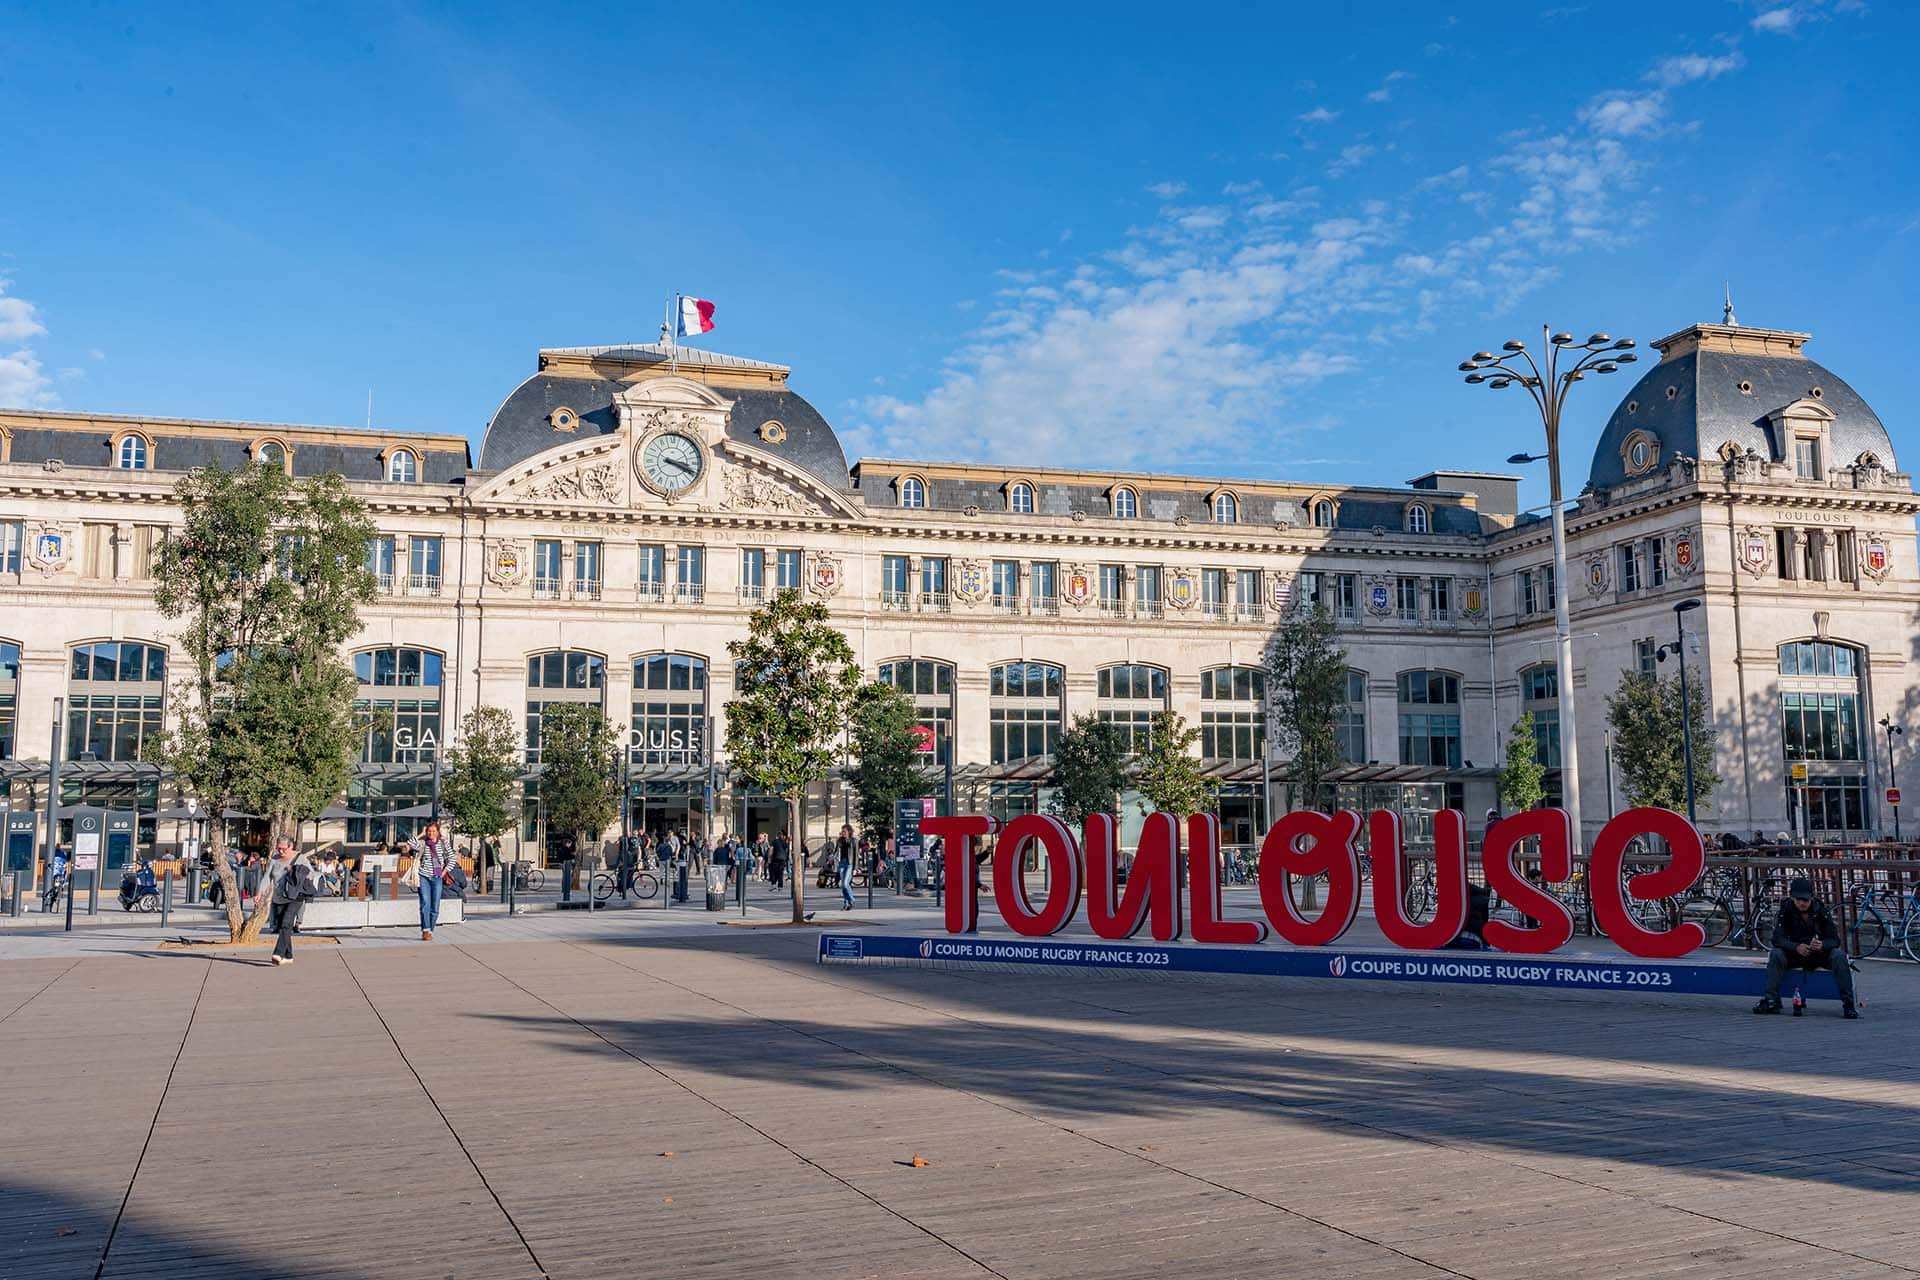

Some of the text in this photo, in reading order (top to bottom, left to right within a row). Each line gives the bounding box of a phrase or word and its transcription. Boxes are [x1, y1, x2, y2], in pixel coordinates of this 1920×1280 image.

[1776, 511, 1850, 522] TOULOUSE
[561, 524, 780, 543] CHEMINS DE FER DU MIDI
[935, 943, 1169, 965] COUPE DU MONDE RUGBY FRANCE 2023
[1351, 960, 1672, 986] COUPE DU MONDE RUGBY FRANCE 2023
